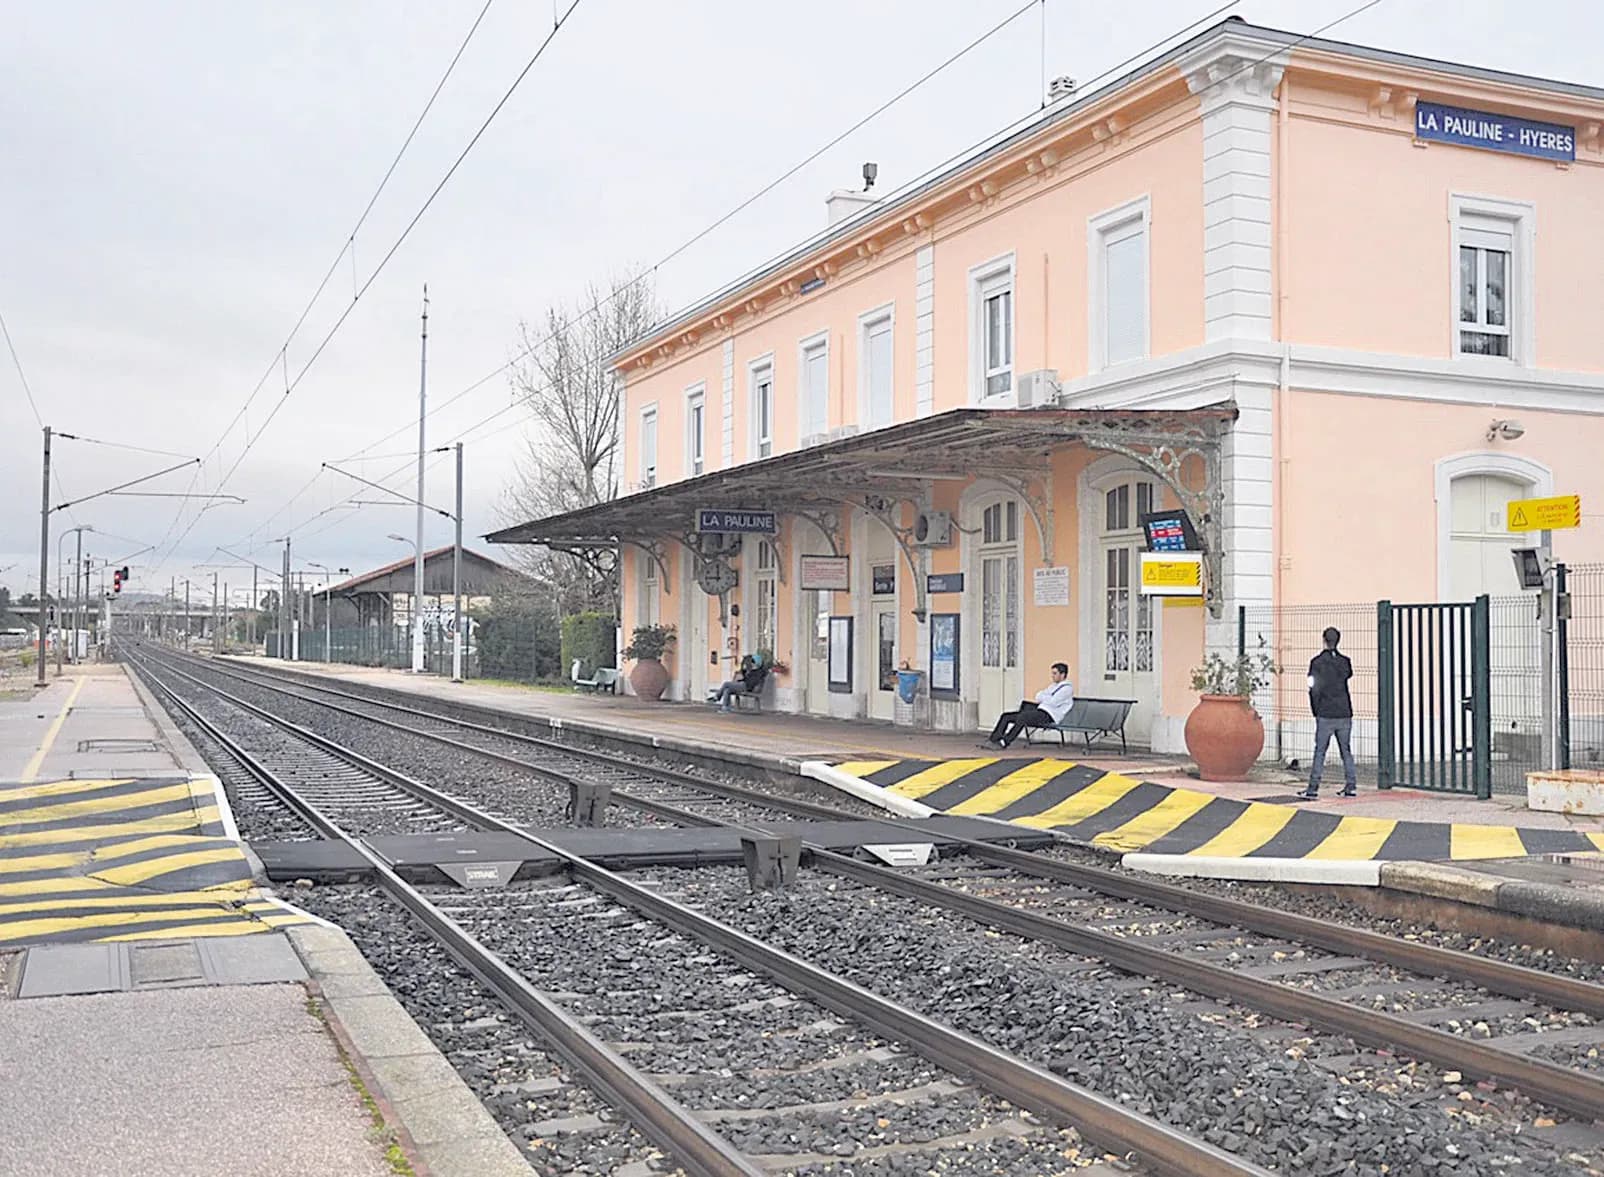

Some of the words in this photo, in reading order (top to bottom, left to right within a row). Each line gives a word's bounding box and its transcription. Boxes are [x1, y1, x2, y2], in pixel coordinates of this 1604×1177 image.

[1418, 111, 1438, 131] LA
[1444, 116, 1503, 141] PAULINE
[1520, 129, 1573, 152] HYERES
[702, 514, 720, 526] LA
[724, 515, 773, 528] PAULINE
